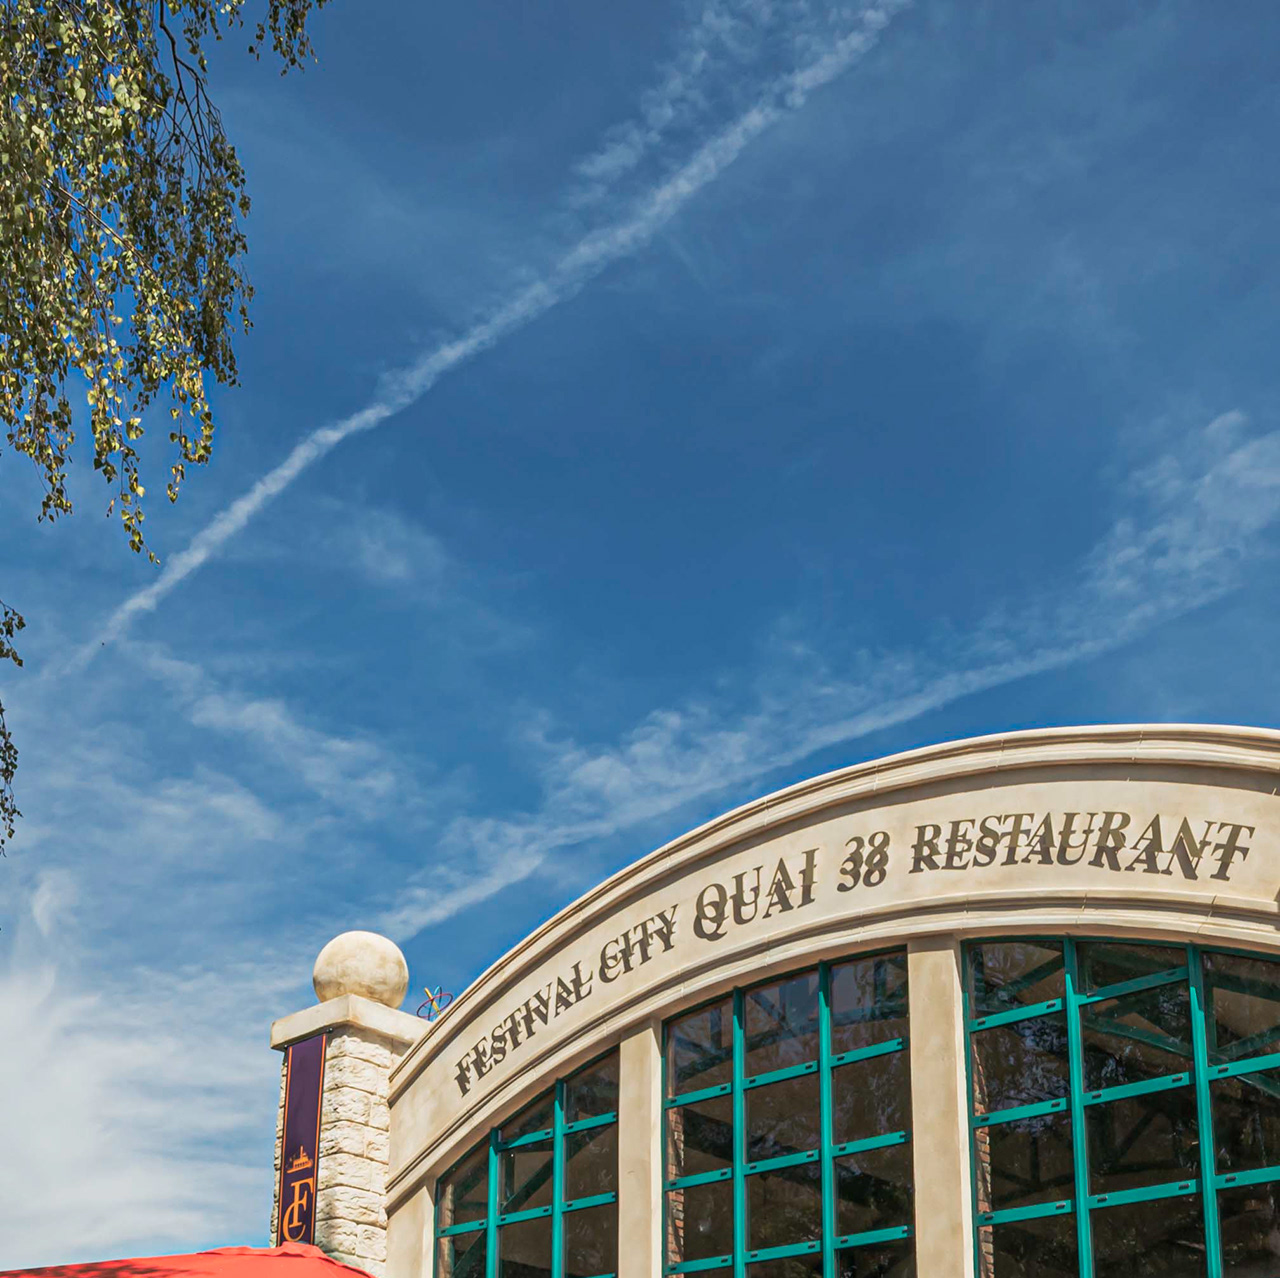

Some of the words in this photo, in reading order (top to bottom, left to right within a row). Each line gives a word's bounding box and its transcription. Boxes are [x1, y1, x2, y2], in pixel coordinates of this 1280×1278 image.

[455, 961, 594, 1090] FESTIVAL
[599, 903, 679, 976] CITY
[694, 848, 820, 932] QUAI
[837, 831, 891, 884] 38
[909, 811, 1255, 872] RESTAURANT
